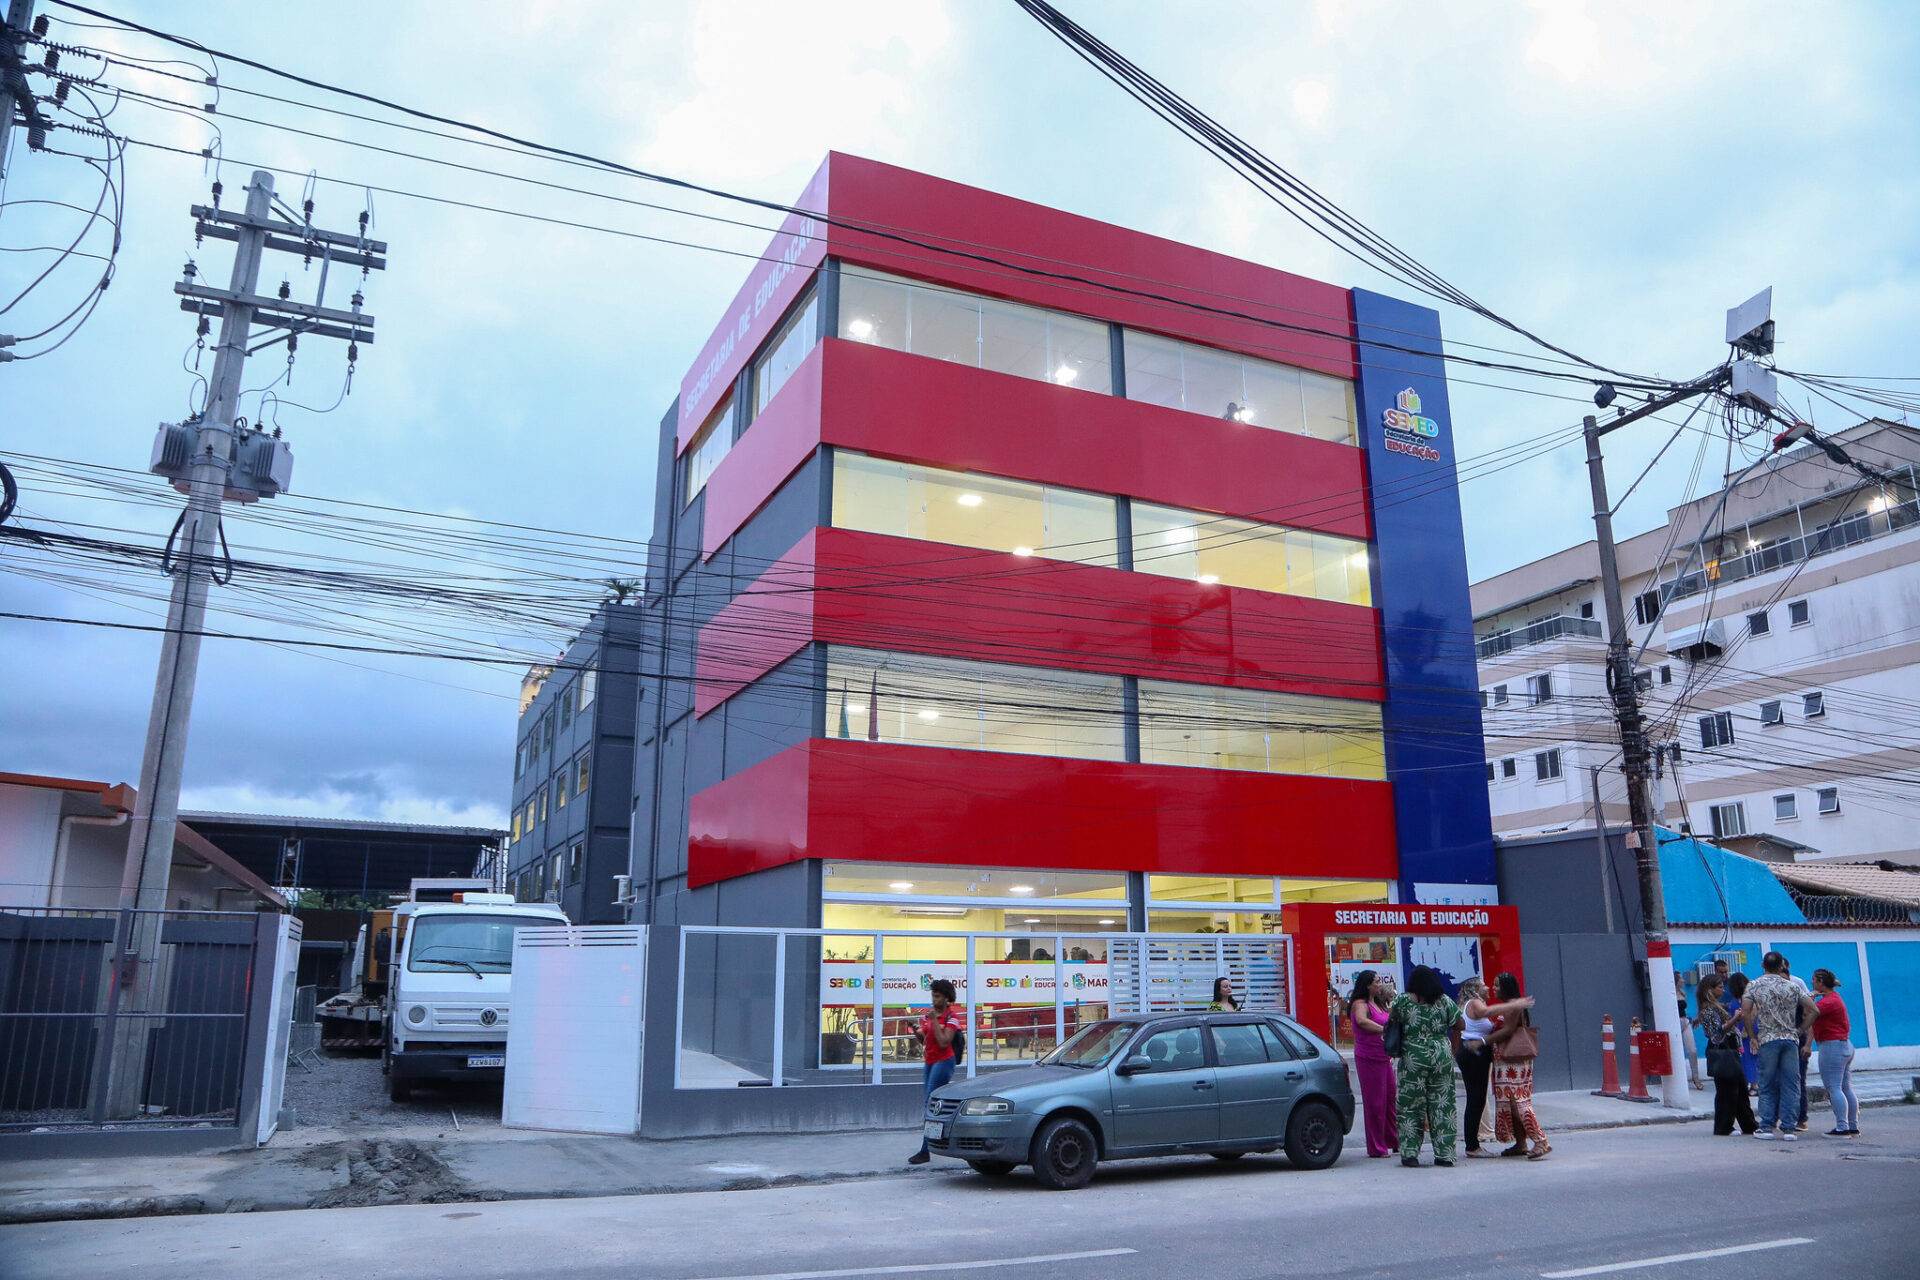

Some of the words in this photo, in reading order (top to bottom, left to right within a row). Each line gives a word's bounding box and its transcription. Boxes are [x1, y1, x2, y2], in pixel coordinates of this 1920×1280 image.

[685, 329, 735, 419] SECRETARIA
[738, 303, 752, 342] DE
[754, 216, 815, 319] EDUCAÇÃO
[1385, 409, 1439, 437] SEMED
[1386, 439, 1440, 460] EDUCAÇÃO
[1335, 910, 1408, 925] SECRETARIA
[1411, 911, 1427, 925] DE
[1431, 909, 1489, 928] EDUCAÇÃO
[829, 977, 862, 989] SEMED
[951, 979, 967, 989] RIC
[986, 977, 1017, 988] SEMED
[1088, 978, 1108, 987] MAR
